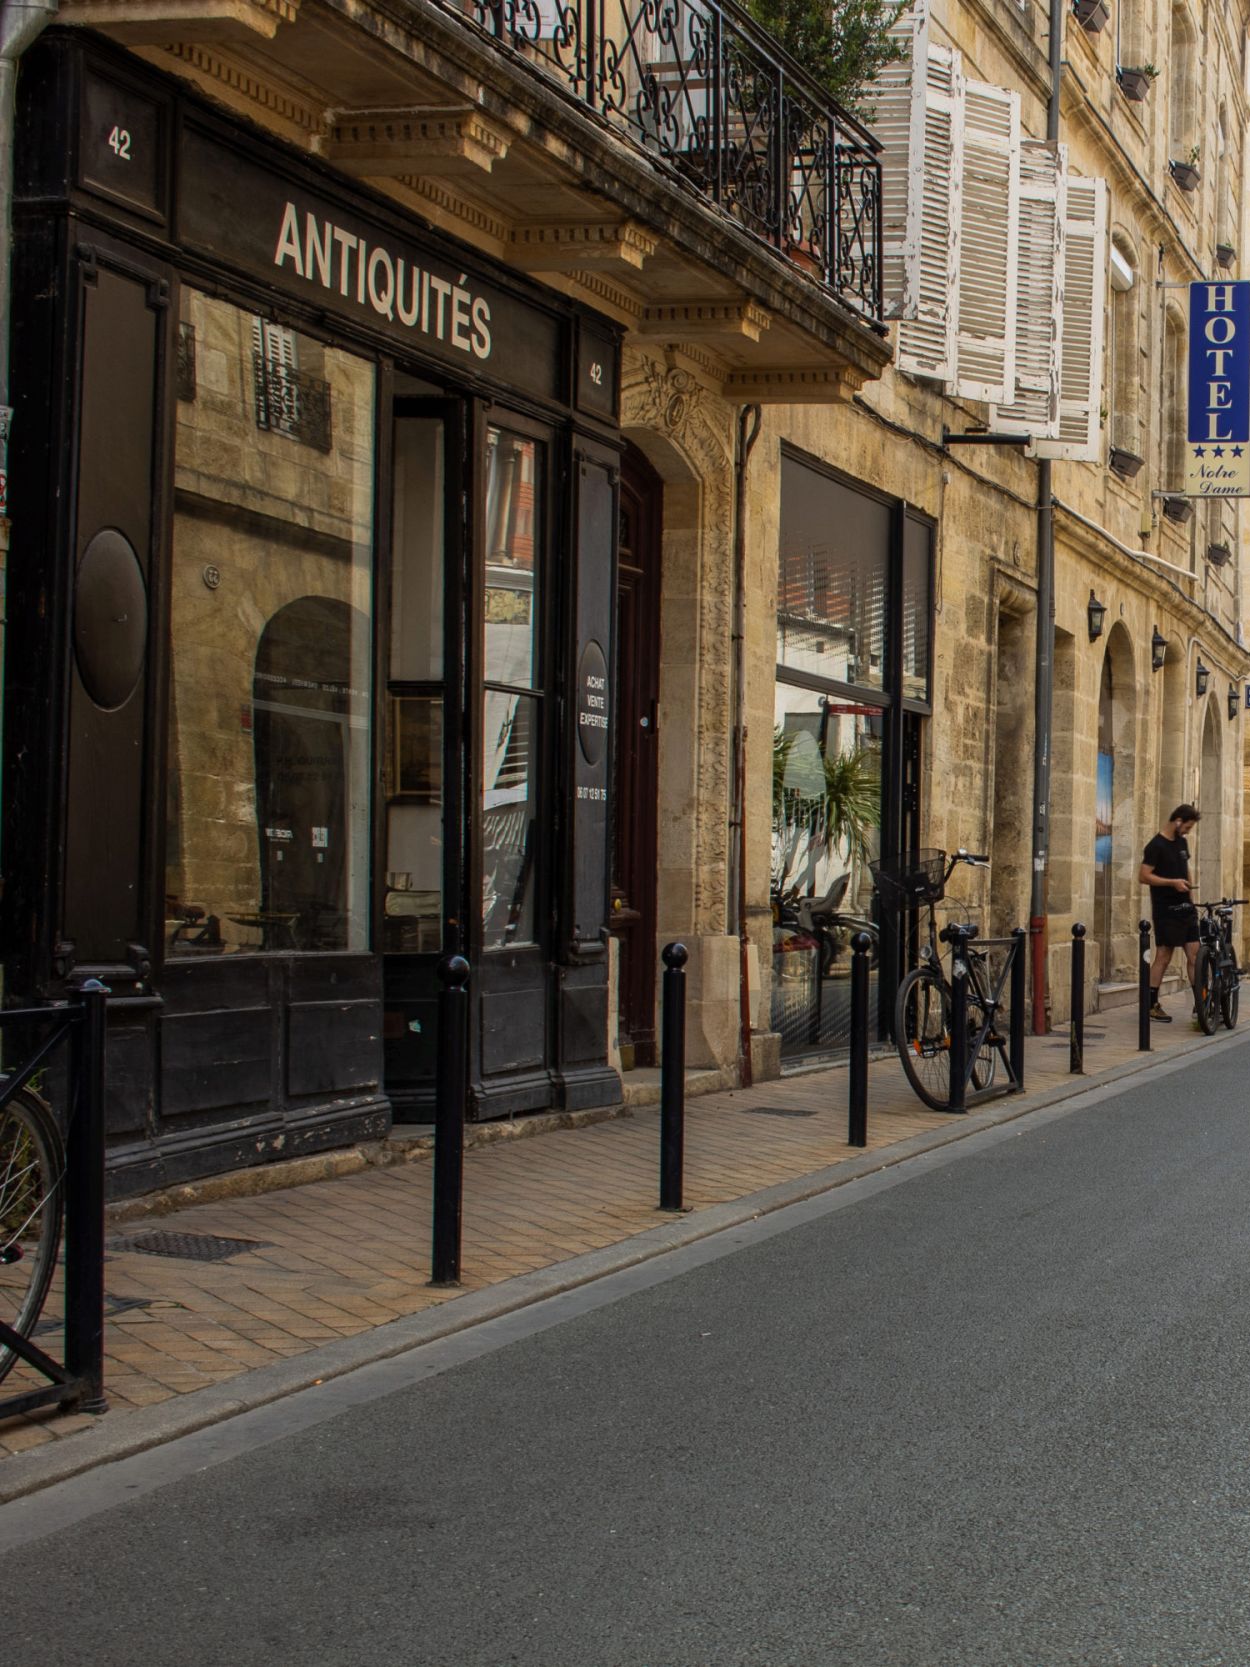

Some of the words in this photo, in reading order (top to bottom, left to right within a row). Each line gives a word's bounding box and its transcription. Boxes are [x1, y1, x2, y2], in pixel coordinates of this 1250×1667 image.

[109, 126, 131, 160] 42
[274, 201, 491, 359] ANTIQUITÉS
[1204, 285, 1238, 440] HOTEL
[590, 362, 602, 385] 42
[1190, 464, 1239, 479] Notre
[1200, 481, 1243, 494] Dame
[586, 675, 605, 690] ACHAT
[586, 694, 605, 709] VENTE
[580, 713, 608, 728] EXPERTISE
